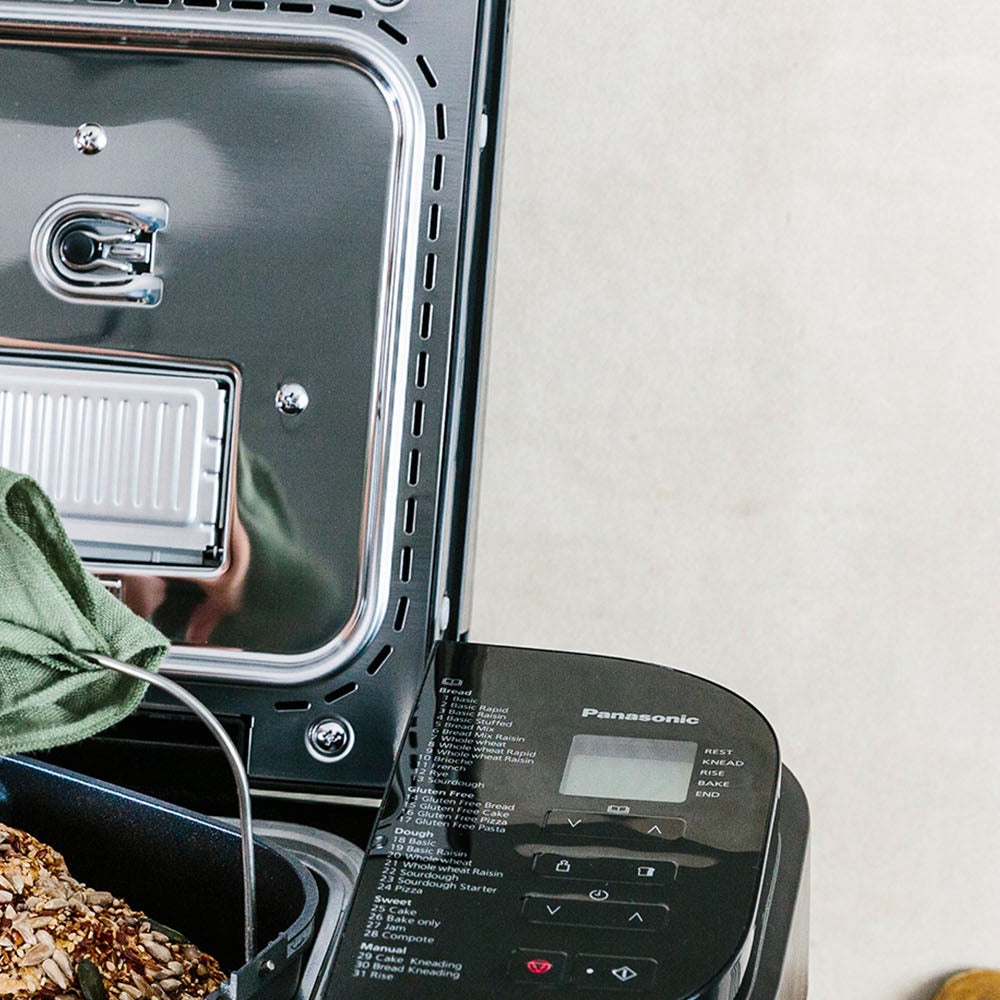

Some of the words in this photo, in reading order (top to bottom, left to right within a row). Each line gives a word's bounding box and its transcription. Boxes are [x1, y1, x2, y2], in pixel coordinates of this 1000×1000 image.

[439, 687, 472, 696] Bread
[448, 709, 475, 717] Basic
[477, 712, 507, 720] Raisin
[479, 705, 509, 713] Rapid
[581, 707, 700, 725] Panasonic
[444, 722, 473, 730] Bread
[475, 718, 513, 727] Stuffed
[441, 736, 474, 744] Whole
[442, 729, 472, 737] Bread
[495, 734, 525, 742] Raisin
[439, 742, 472, 751] Whole
[474, 746, 505, 754] wheat
[506, 749, 537, 758] Rapid
[433, 756, 474, 765] Brioche
[437, 749, 470, 758] Whole
[472, 753, 502, 761] wheat
[504, 756, 535, 764] Raisin
[702, 759, 744, 767] KNEAD
[427, 777, 485, 789] Sourdough
[698, 780, 730, 788] BAKE
[408, 786, 446, 796] Gluten
[450, 790, 475, 798] Free
[696, 790, 720, 798] END
[422, 796, 457, 805] Gluten
[458, 799, 482, 807] Free
[484, 801, 515, 810] Bread
[419, 803, 454, 813] Gluten
[457, 807, 480, 815] Free
[482, 809, 510, 817] Cake
[417, 811, 452, 821] Gluten
[455, 814, 478, 822] Free
[480, 817, 508, 825] Pizza
[415, 819, 450, 828] Gluten
[453, 822, 475, 830] Free
[478, 824, 506, 833] Pasta
[394, 828, 434, 838] Dough
[408, 839, 436, 847] Basic
[406, 846, 434, 855] Basic
[436, 849, 467, 857] Raisin
[404, 853, 438, 863] Whole
[441, 858, 473, 866] wheat
[382, 867, 396, 875] 22
[400, 869, 459, 882] Sourdough
[385, 859, 398, 867] 21
[403, 861, 436, 871] Whole
[438, 865, 471, 875] wheat
[472, 868, 504, 878] Raisin
[377, 883, 392, 891] 24
[395, 886, 423, 895] Pizza
[380, 875, 394, 883] 23
[398, 877, 457, 890] Sourdough
[460, 883, 497, 893] Starter
[374, 895, 412, 906] Sweet
[371, 905, 385, 913] 25
[389, 906, 417, 915] Cake
[368, 913, 383, 921] 26
[386, 915, 415, 924] Bake
[418, 918, 441, 927] only
[384, 923, 406, 932] Jam
[364, 930, 379, 938] 28
[382, 932, 435, 944] Compote
[360, 942, 407, 954] Manual
[357, 952, 372, 960] 29
[375, 954, 404, 963] Cake
[410, 958, 462, 970] Kneading
[353, 969, 365, 977] 31
[370, 971, 394, 981] Rise
[355, 961, 370, 969] 30
[372, 962, 404, 973] Bread
[408, 966, 460, 980] Kneading
